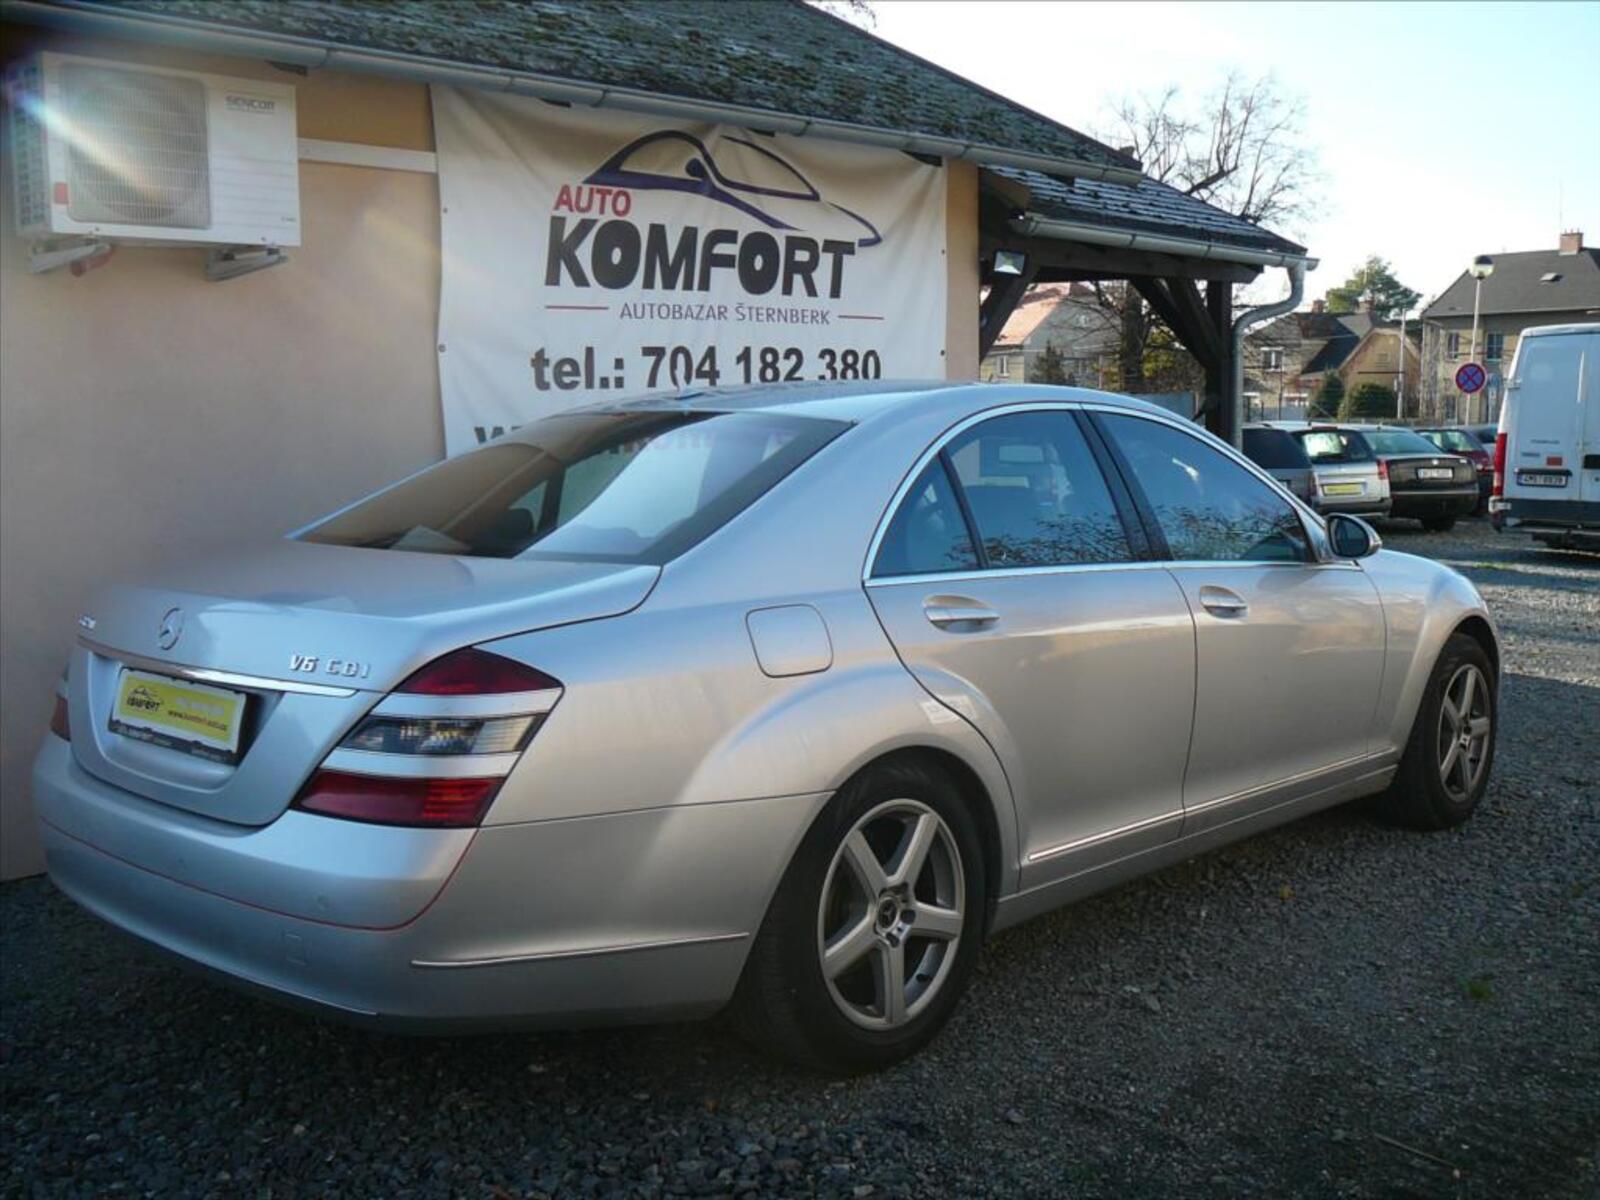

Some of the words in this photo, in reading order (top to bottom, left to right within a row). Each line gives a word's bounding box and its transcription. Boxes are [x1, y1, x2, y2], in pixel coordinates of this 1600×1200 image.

[553, 184, 632, 217] AUTO
[545, 215, 856, 299] KOMFORT
[619, 302, 729, 322] AUTOBAZAR
[735, 302, 831, 325] ŠTERNBERK
[531, 346, 625, 391] tel.:
[641, 345, 720, 391] 704
[736, 346, 805, 384] 182
[818, 348, 881, 381] 380
[289, 654, 319, 673] V6
[325, 658, 371, 679] CDI
